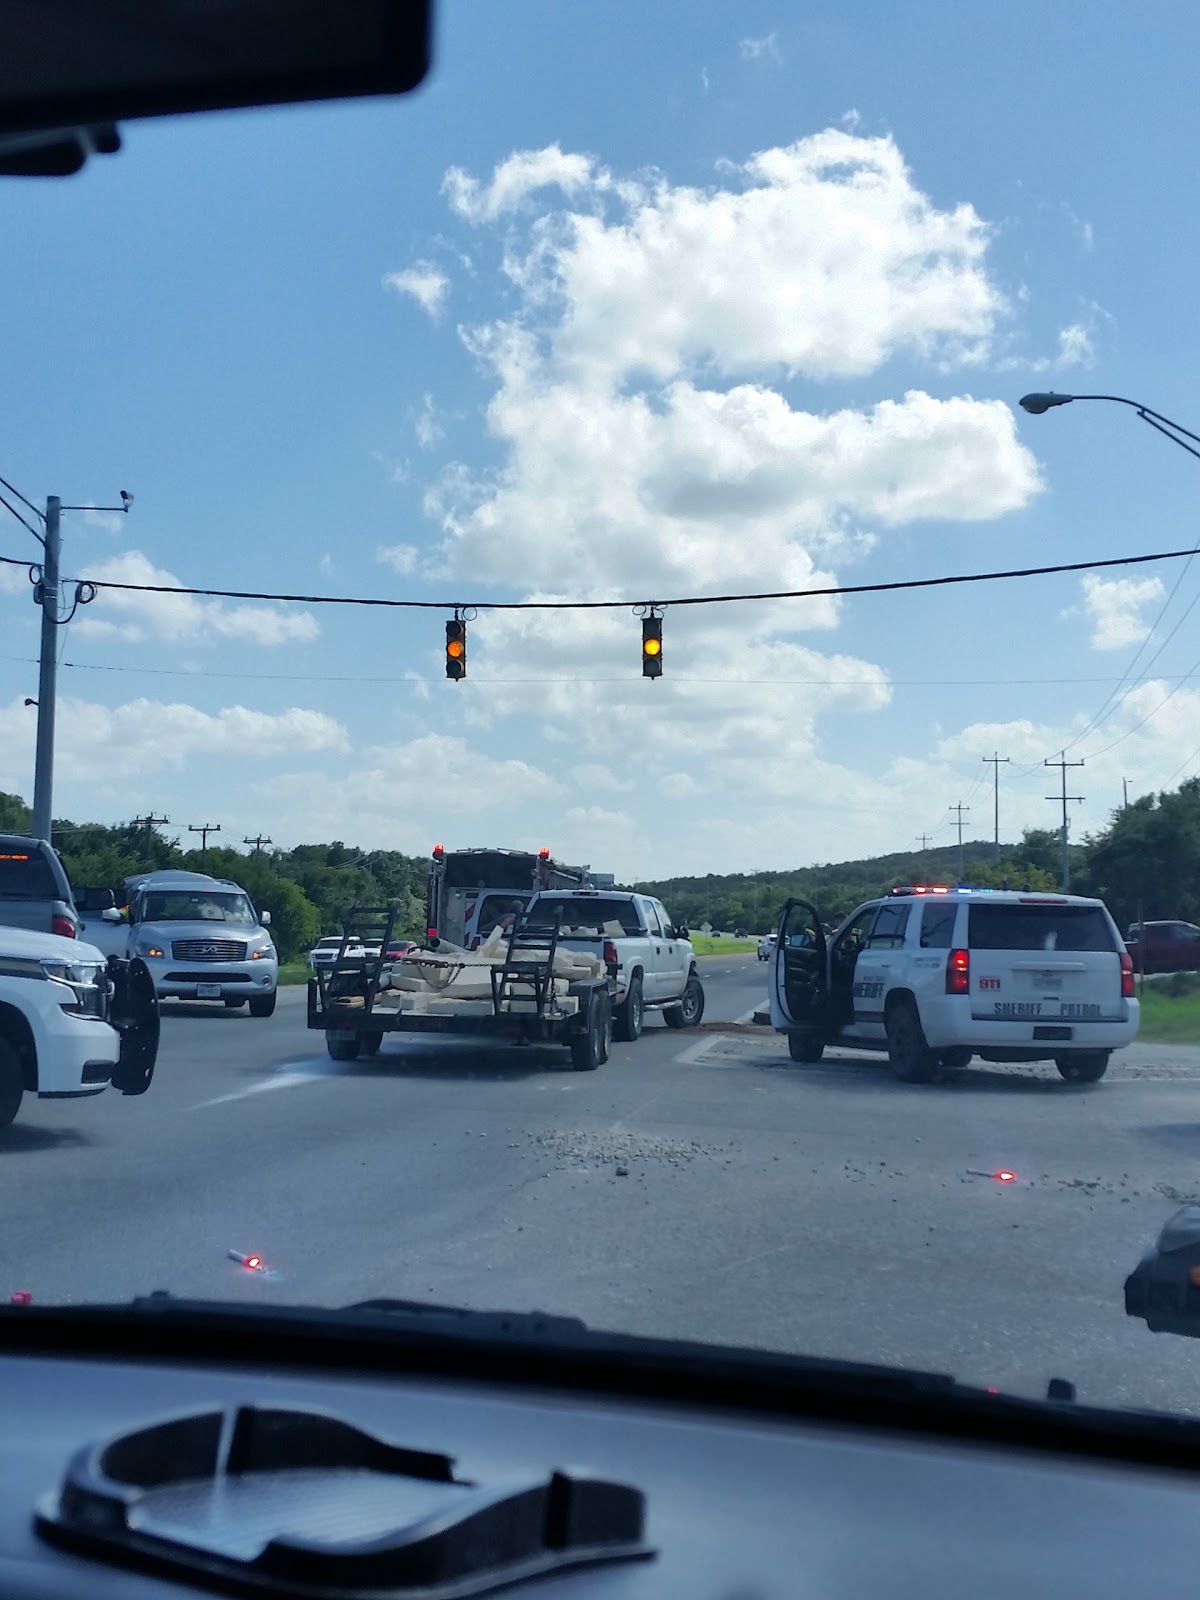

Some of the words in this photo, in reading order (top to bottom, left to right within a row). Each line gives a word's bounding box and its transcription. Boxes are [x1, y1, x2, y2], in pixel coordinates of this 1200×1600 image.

[979, 978, 1001, 991] 911
[994, 1002, 1043, 1015] SHERIFF
[1060, 1003, 1101, 1017] PATROL
